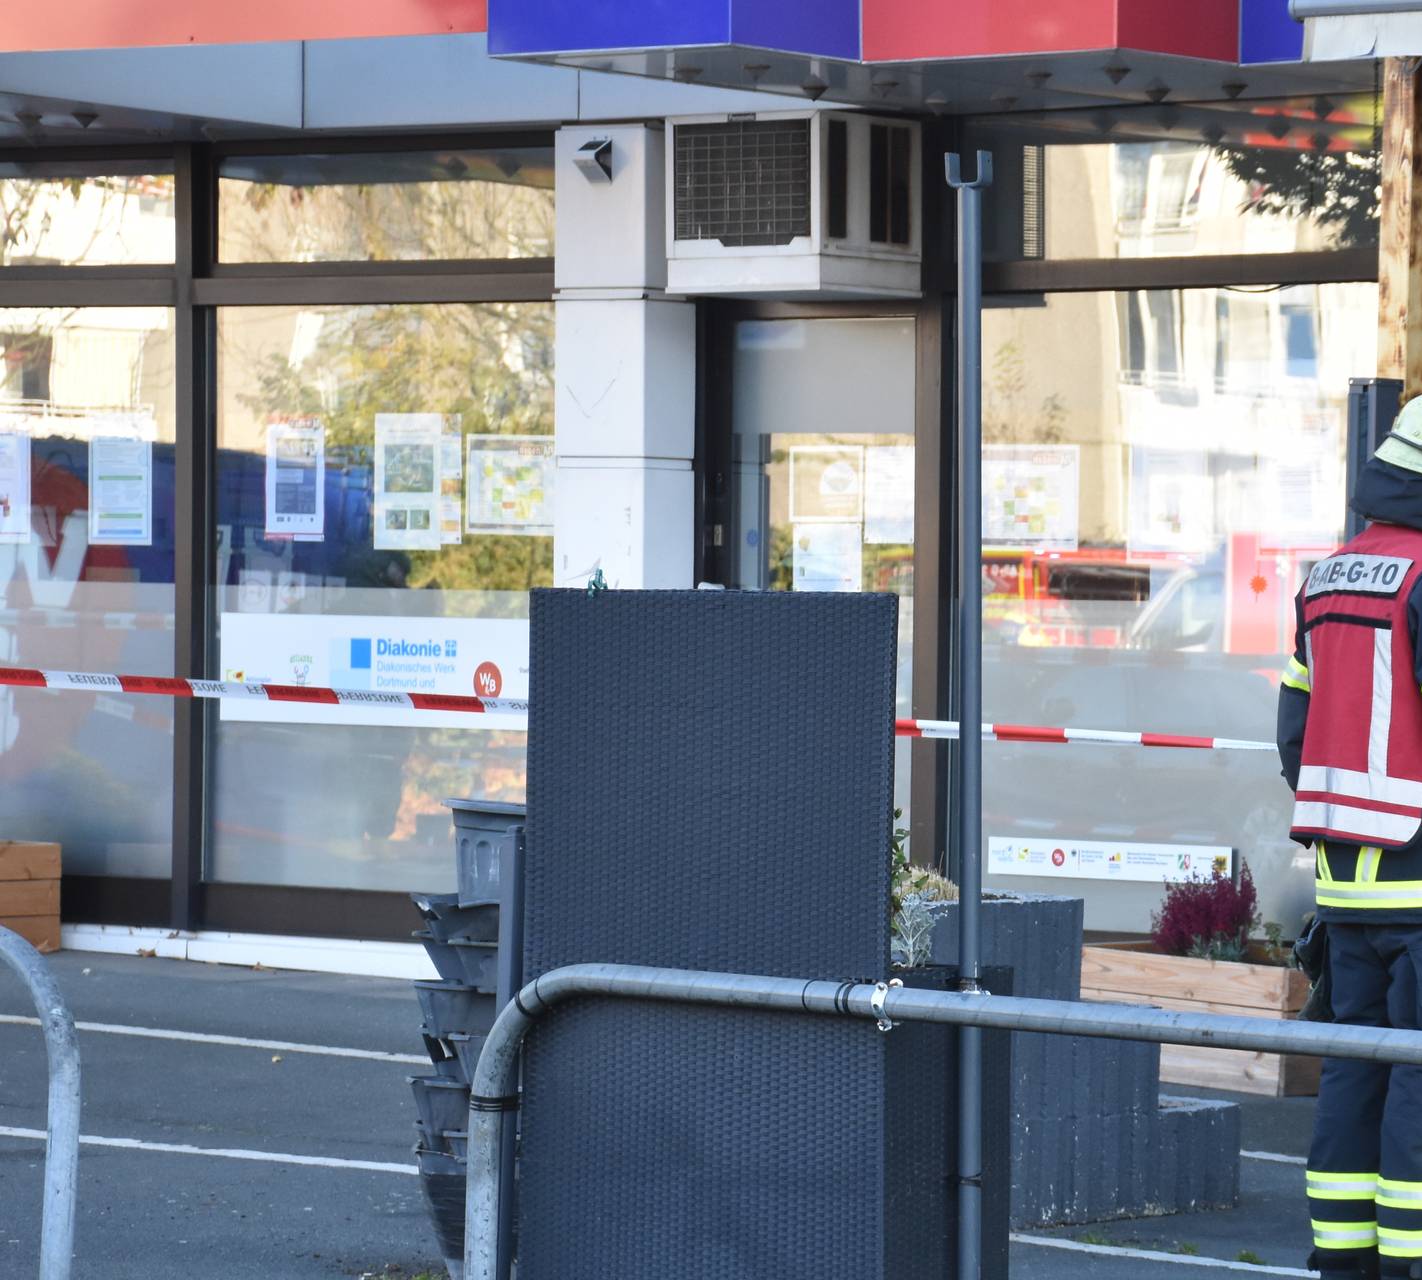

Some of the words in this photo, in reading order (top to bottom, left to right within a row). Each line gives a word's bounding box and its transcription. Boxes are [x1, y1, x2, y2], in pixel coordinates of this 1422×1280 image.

[377, 639, 441, 656] Diakonie
[377, 661, 432, 673] Diakonisches
[434, 663, 455, 674] Werk
[377, 676, 417, 688] Dortmund
[419, 679, 435, 688] und
